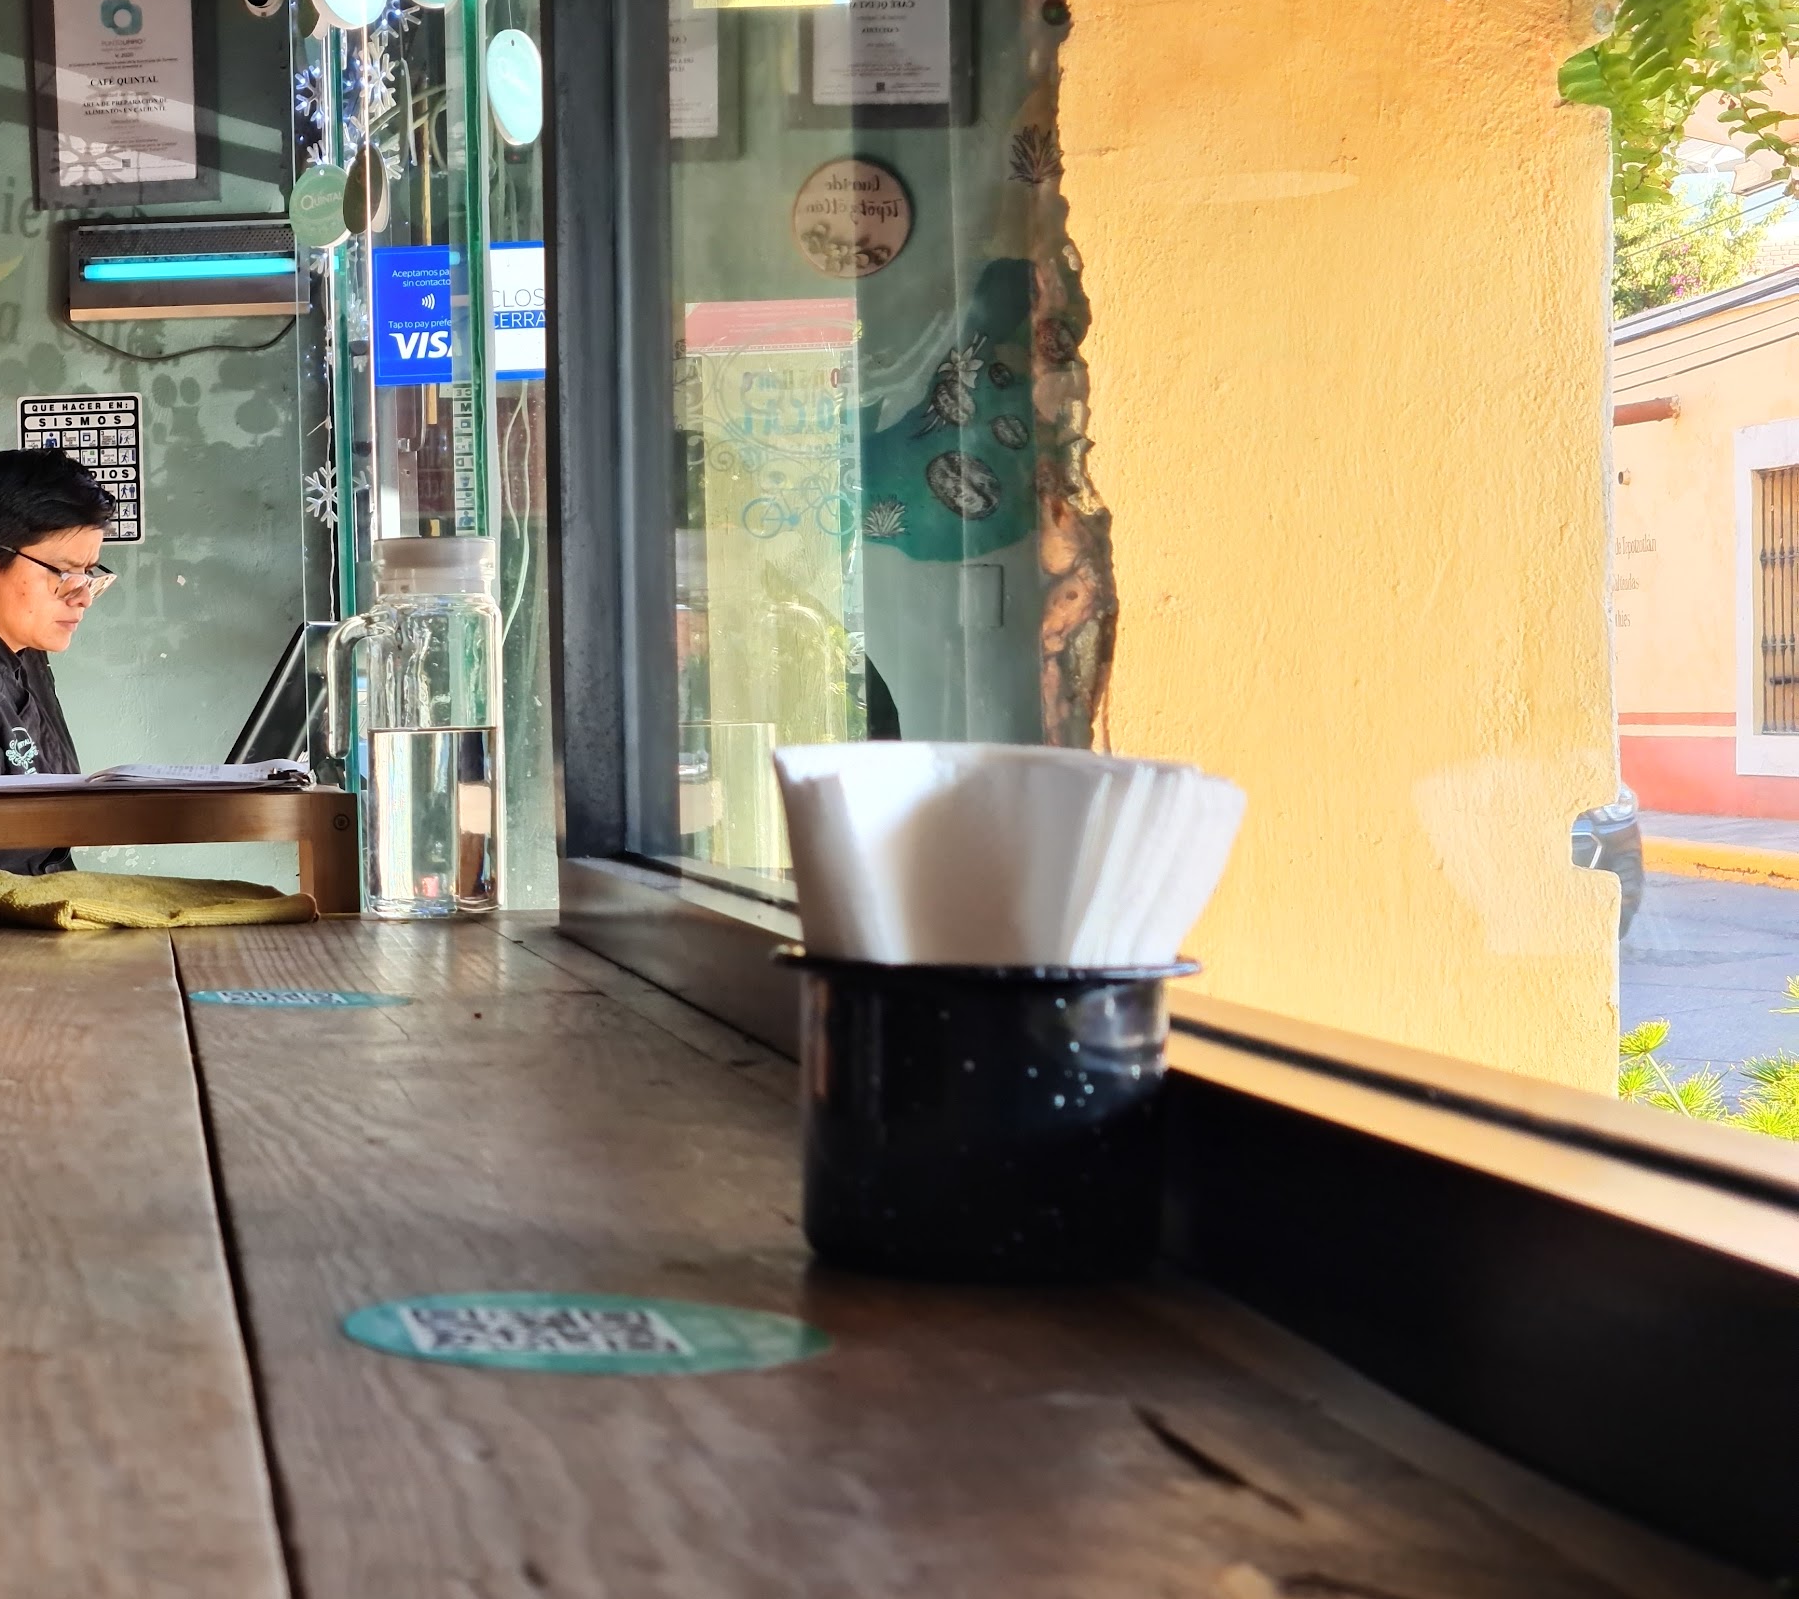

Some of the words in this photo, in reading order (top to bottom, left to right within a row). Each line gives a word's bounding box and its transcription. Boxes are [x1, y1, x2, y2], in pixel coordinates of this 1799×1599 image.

[90, 76, 115, 86] CAFÉ
[117, 76, 158, 86] QUINTAL
[392, 269, 438, 278] Aceptamos
[492, 288, 545, 308] CLOS
[388, 321, 404, 329] Tap
[415, 321, 430, 329] pay
[431, 318, 452, 328] prefe
[494, 311, 545, 328] CERRA
[39, 415, 121, 427] SISMOS
